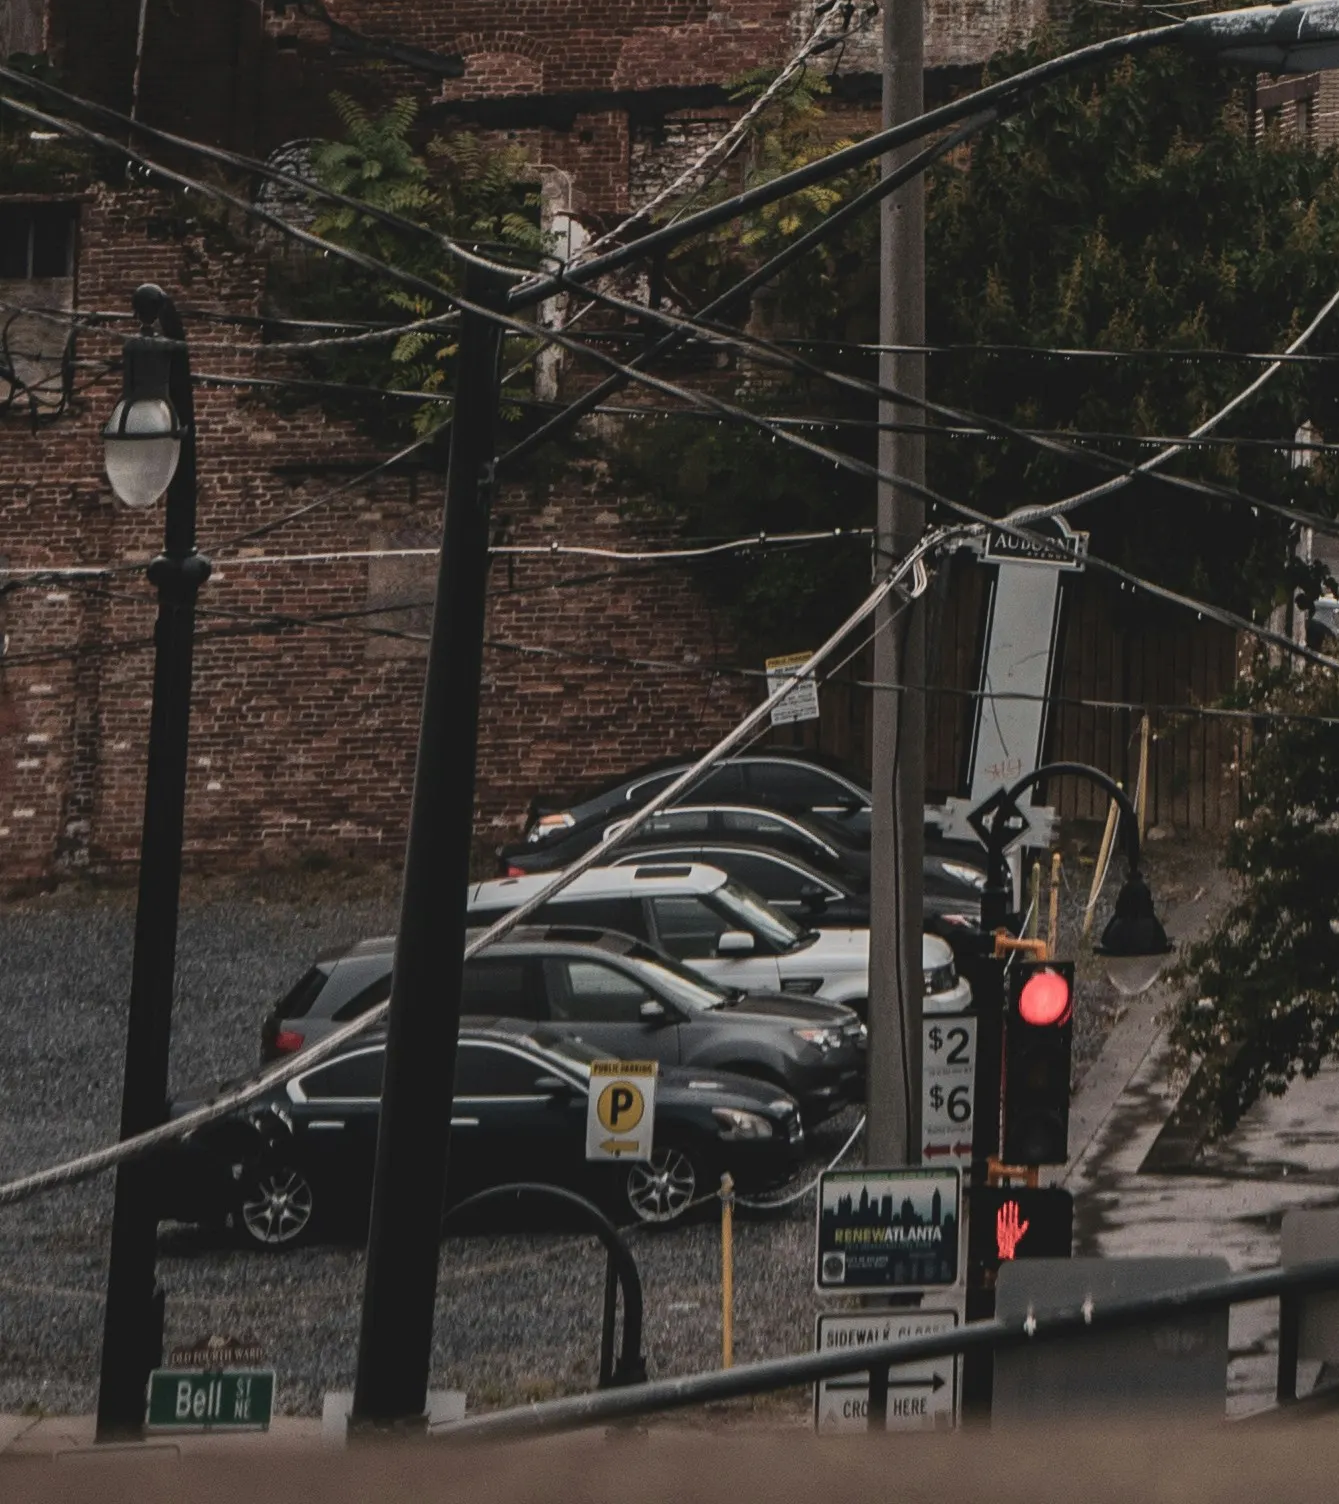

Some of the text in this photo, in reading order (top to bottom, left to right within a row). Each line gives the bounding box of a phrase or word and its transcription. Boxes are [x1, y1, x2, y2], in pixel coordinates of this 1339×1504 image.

[928, 1026, 970, 1065] $2
[610, 1087, 633, 1125] P
[929, 1084, 971, 1123] $6
[175, 1378, 222, 1419] Bell
[233, 1398, 252, 1419] NE
[893, 1397, 927, 1417] HERE
